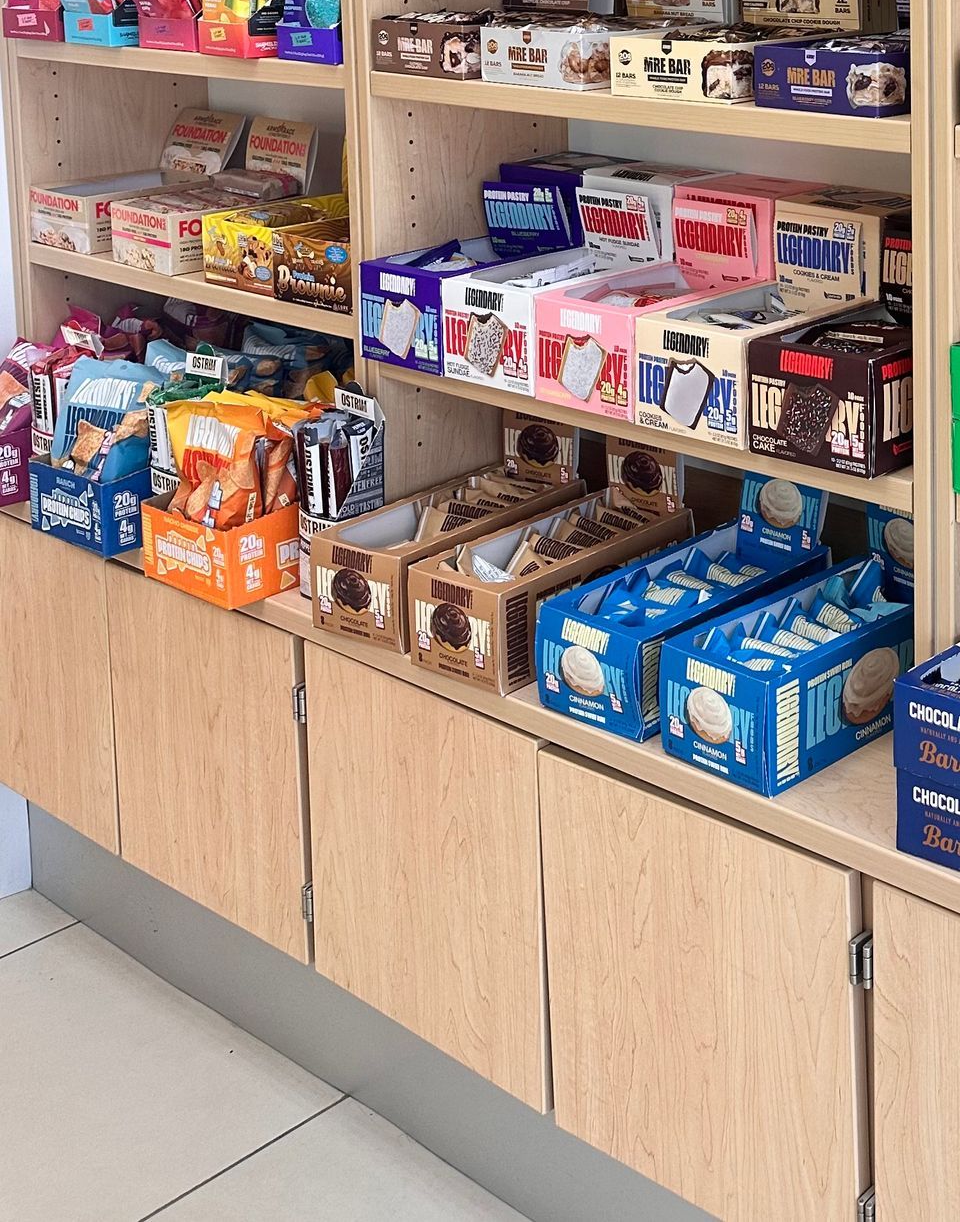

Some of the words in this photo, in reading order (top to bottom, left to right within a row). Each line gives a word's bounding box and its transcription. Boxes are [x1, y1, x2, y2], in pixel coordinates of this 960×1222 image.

[508, 46, 527, 62] MRE
[529, 48, 547, 63] BAR
[644, 57, 667, 74] MRE
[669, 58, 691, 75] BAR
[787, 67, 809, 85] MRE
[811, 70, 836, 87] BAR
[175, 125, 227, 144] FOUNDATION
[251, 134, 301, 156] FOUNDATION
[30, 190, 79, 212] FOUNDATION
[111, 206, 162, 229] FOUNDATION
[777, 233, 851, 274] LEGENDARY
[278, 265, 346, 302] Brownie
[663, 329, 707, 358] LEGENDARY
[447, 367, 470, 377] SUNDAE
[752, 434, 787, 445] CHOCOLATE
[752, 440, 775, 453] CAKE
[339, 616, 368, 628] CHOCOLATE
[438, 652, 468, 666] CHOCOLATE
[568, 694, 605, 712] CINNAMON
[855, 714, 891, 741] CINNAMON
[693, 740, 728, 761] CINNAMON
